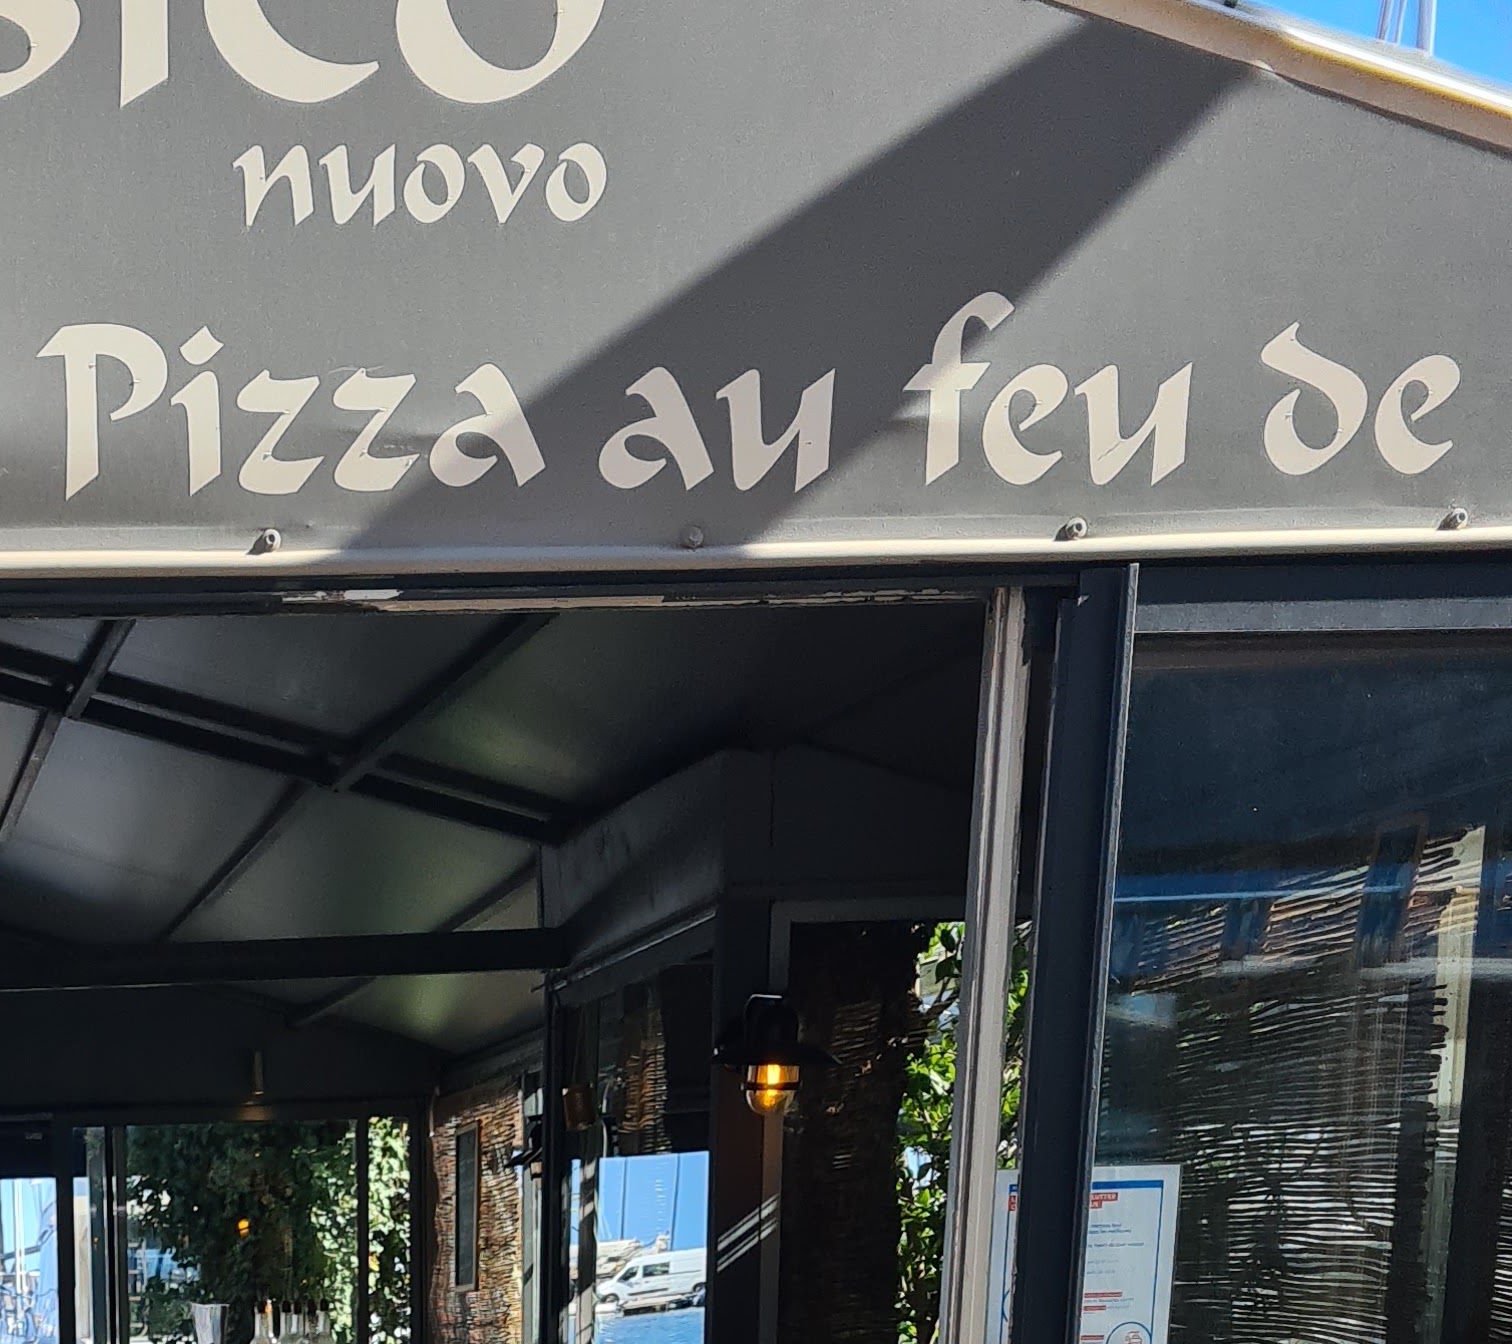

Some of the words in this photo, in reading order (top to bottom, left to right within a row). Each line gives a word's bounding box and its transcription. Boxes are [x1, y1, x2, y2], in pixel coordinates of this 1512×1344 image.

[232, 142, 607, 232] nuovo
[37, 322, 543, 499] Pizza
[598, 364, 836, 492] au
[903, 291, 1192, 488] feu
[1260, 321, 1461, 476] de
